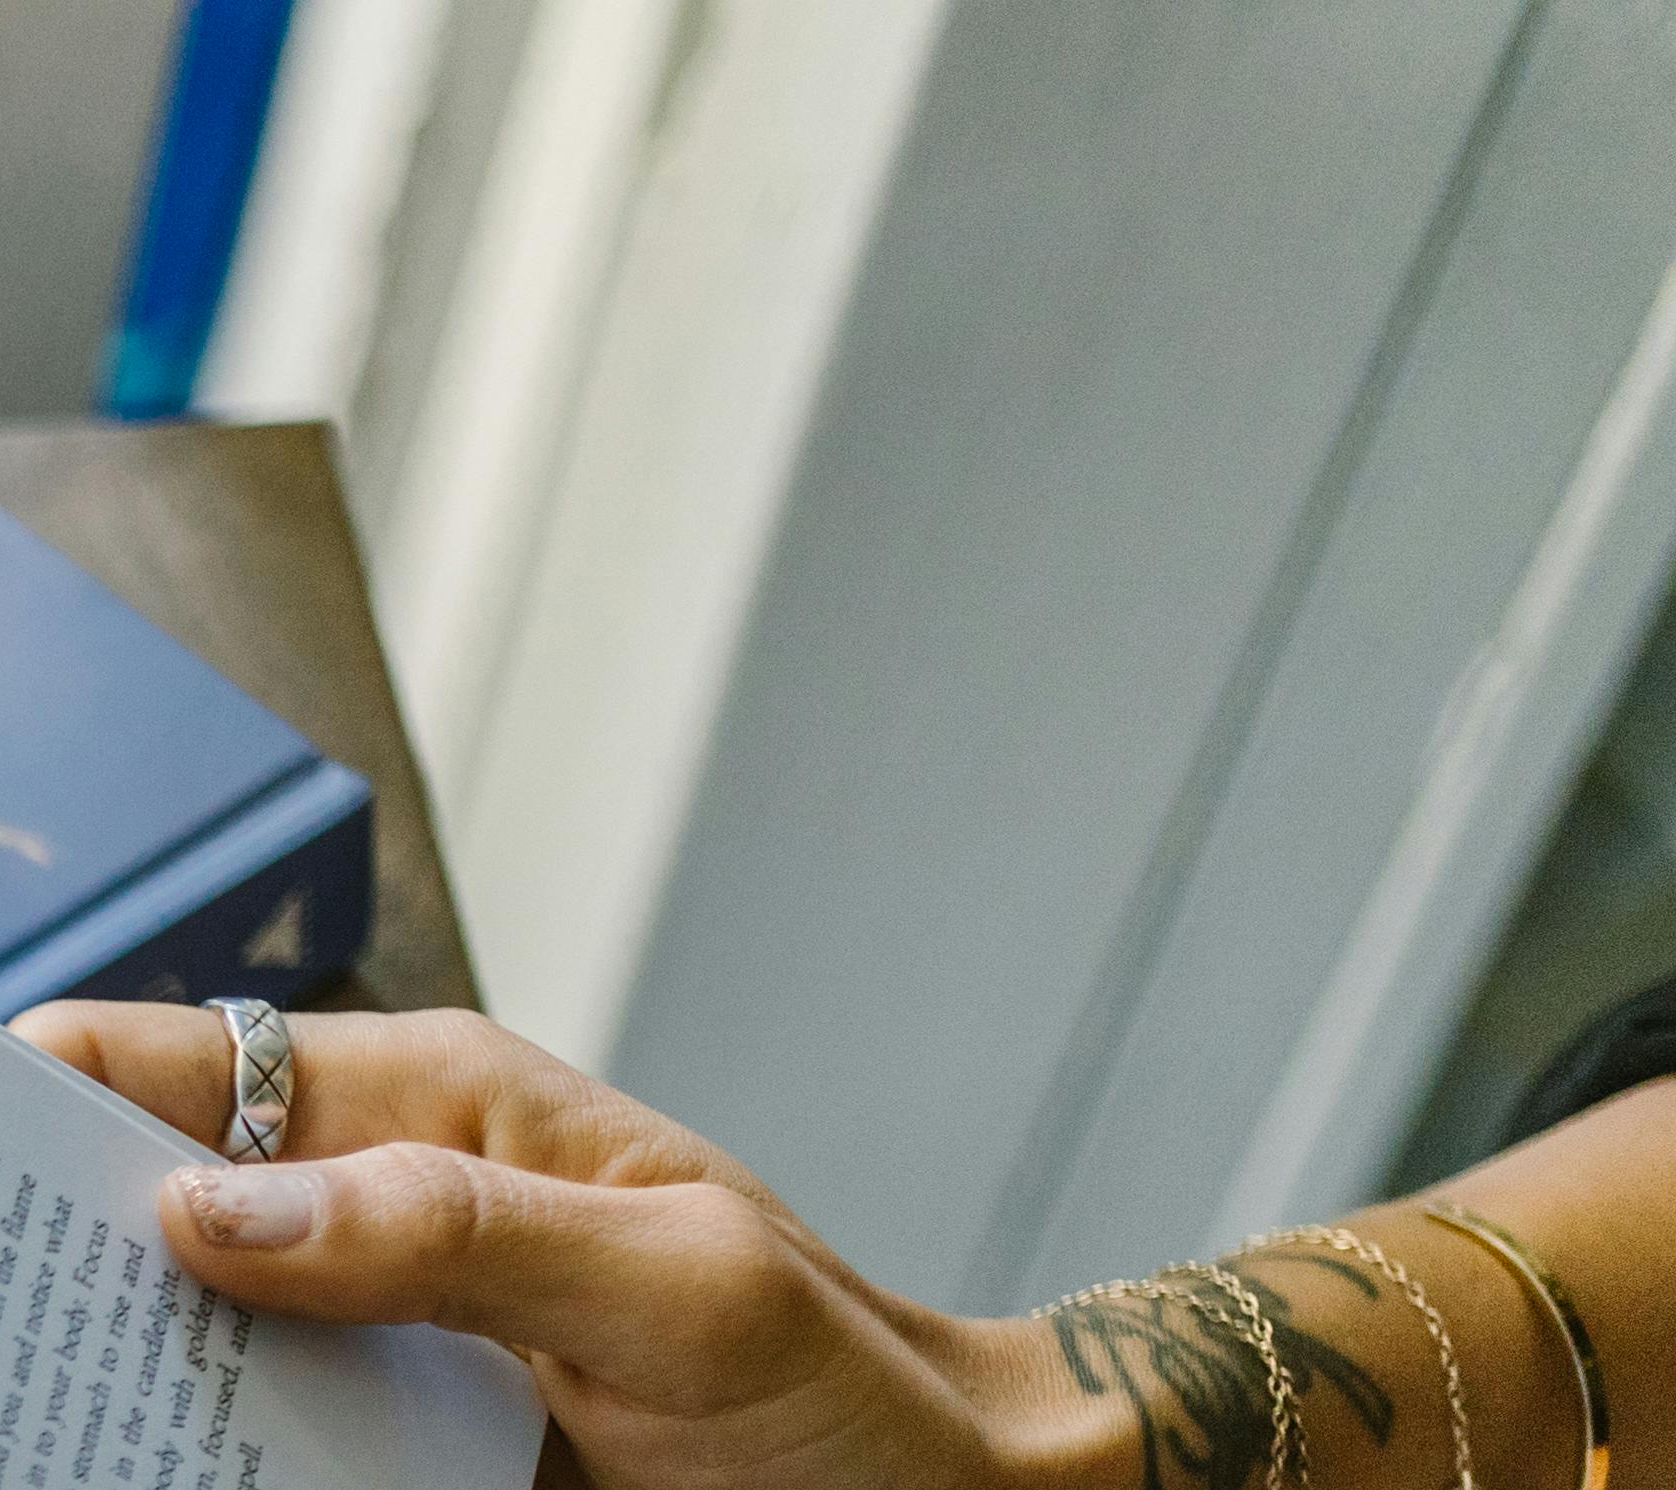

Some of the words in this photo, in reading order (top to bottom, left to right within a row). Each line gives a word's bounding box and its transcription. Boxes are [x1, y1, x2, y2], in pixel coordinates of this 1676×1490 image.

[71, 1219, 109, 1290] Focus
[121, 1236, 146, 1288] and
[52, 1298, 92, 1361] body.
[105, 1294, 131, 1339] rise
[136, 1265, 182, 1398] candlelight.
[97, 1346, 119, 1373] to
[168, 1378, 195, 1429] with
[184, 1285, 219, 1375] golden
[197, 1361, 243, 1460] focused,
[226, 1307, 254, 1357] and
[44, 1364, 72, 1429] your
[32, 1429, 56, 1457] to
[72, 1380, 111, 1483] stomach
[118, 1406, 147, 1446] the
[25, 1463, 48, 1489] in
[109, 1456, 135, 1481] in
